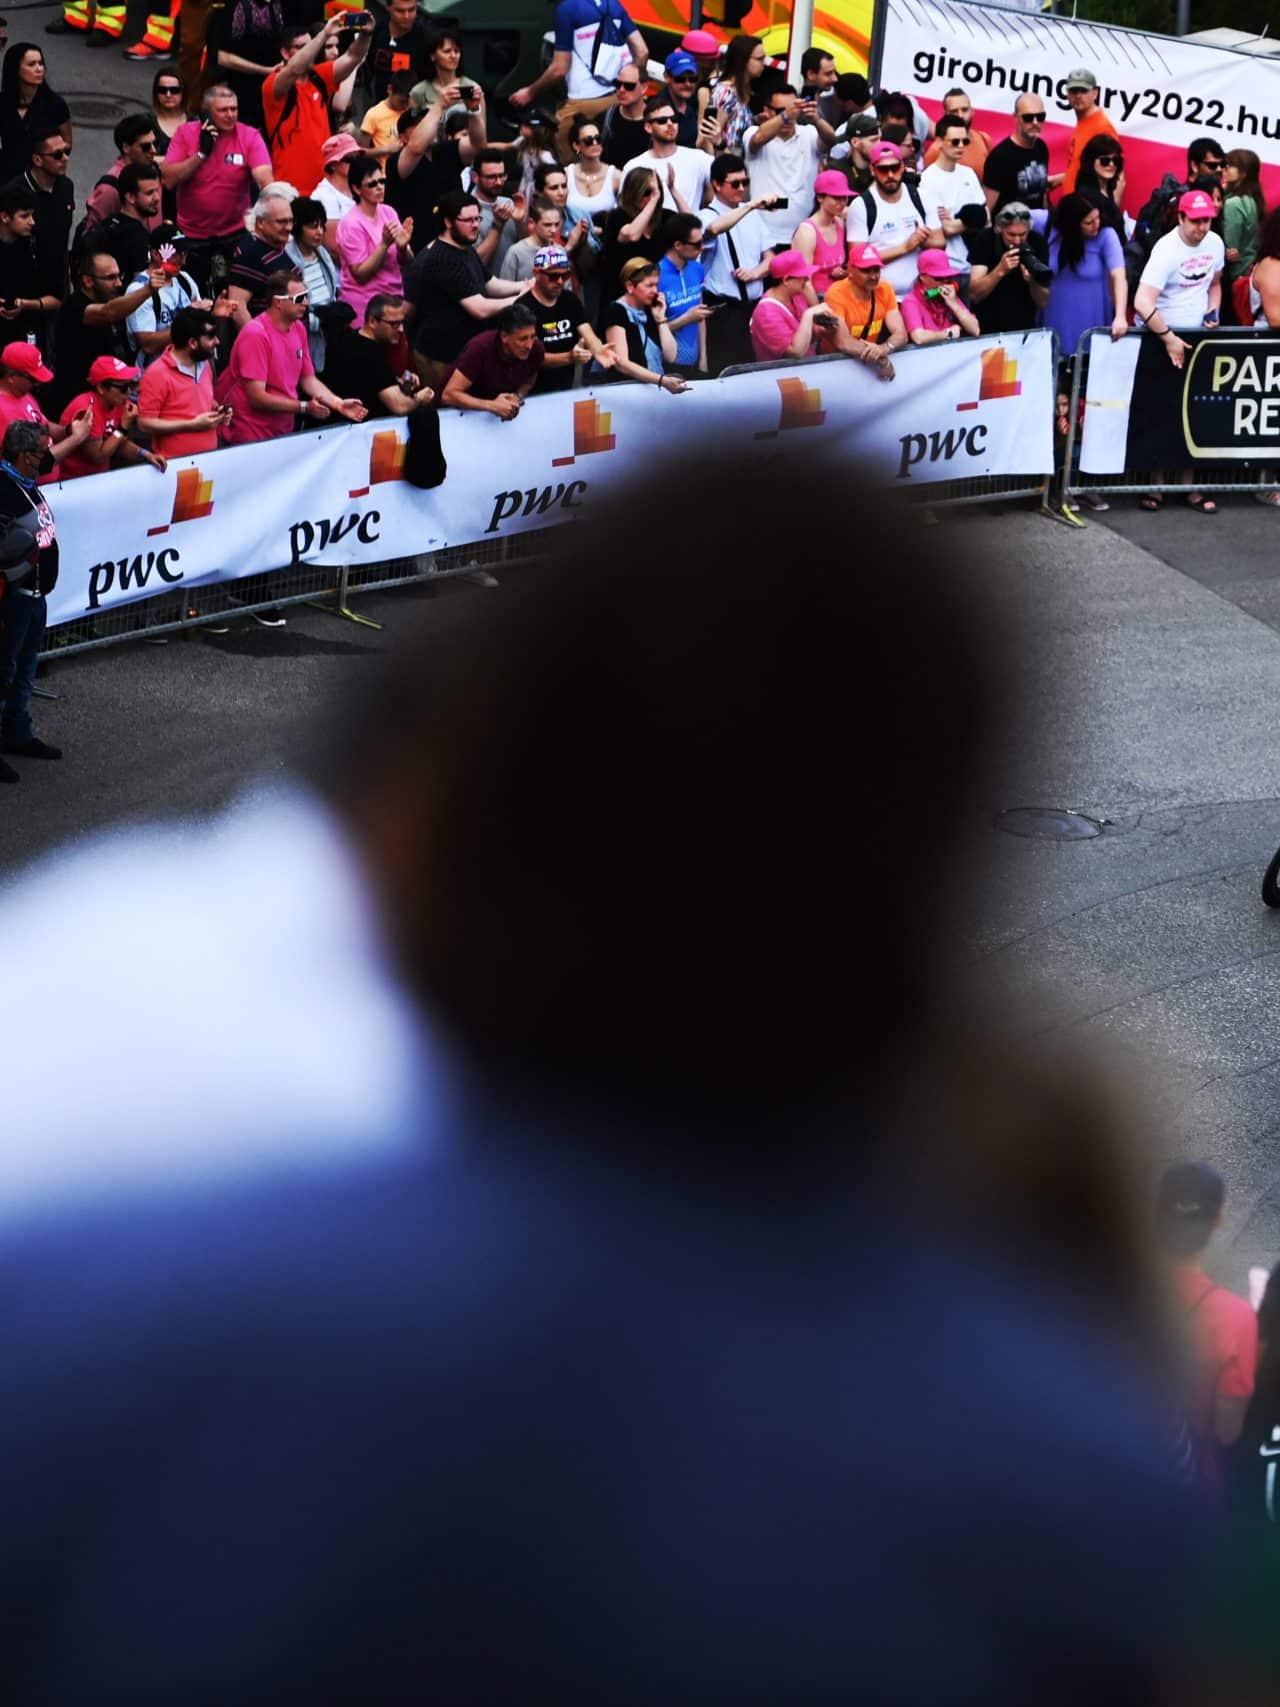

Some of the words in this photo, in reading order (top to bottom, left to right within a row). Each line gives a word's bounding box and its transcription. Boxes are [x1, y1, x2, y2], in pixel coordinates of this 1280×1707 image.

[896, 425, 988, 478] pwc
[484, 480, 588, 534] pwc
[288, 510, 381, 566] pwc
[85, 548, 184, 611] pwc
